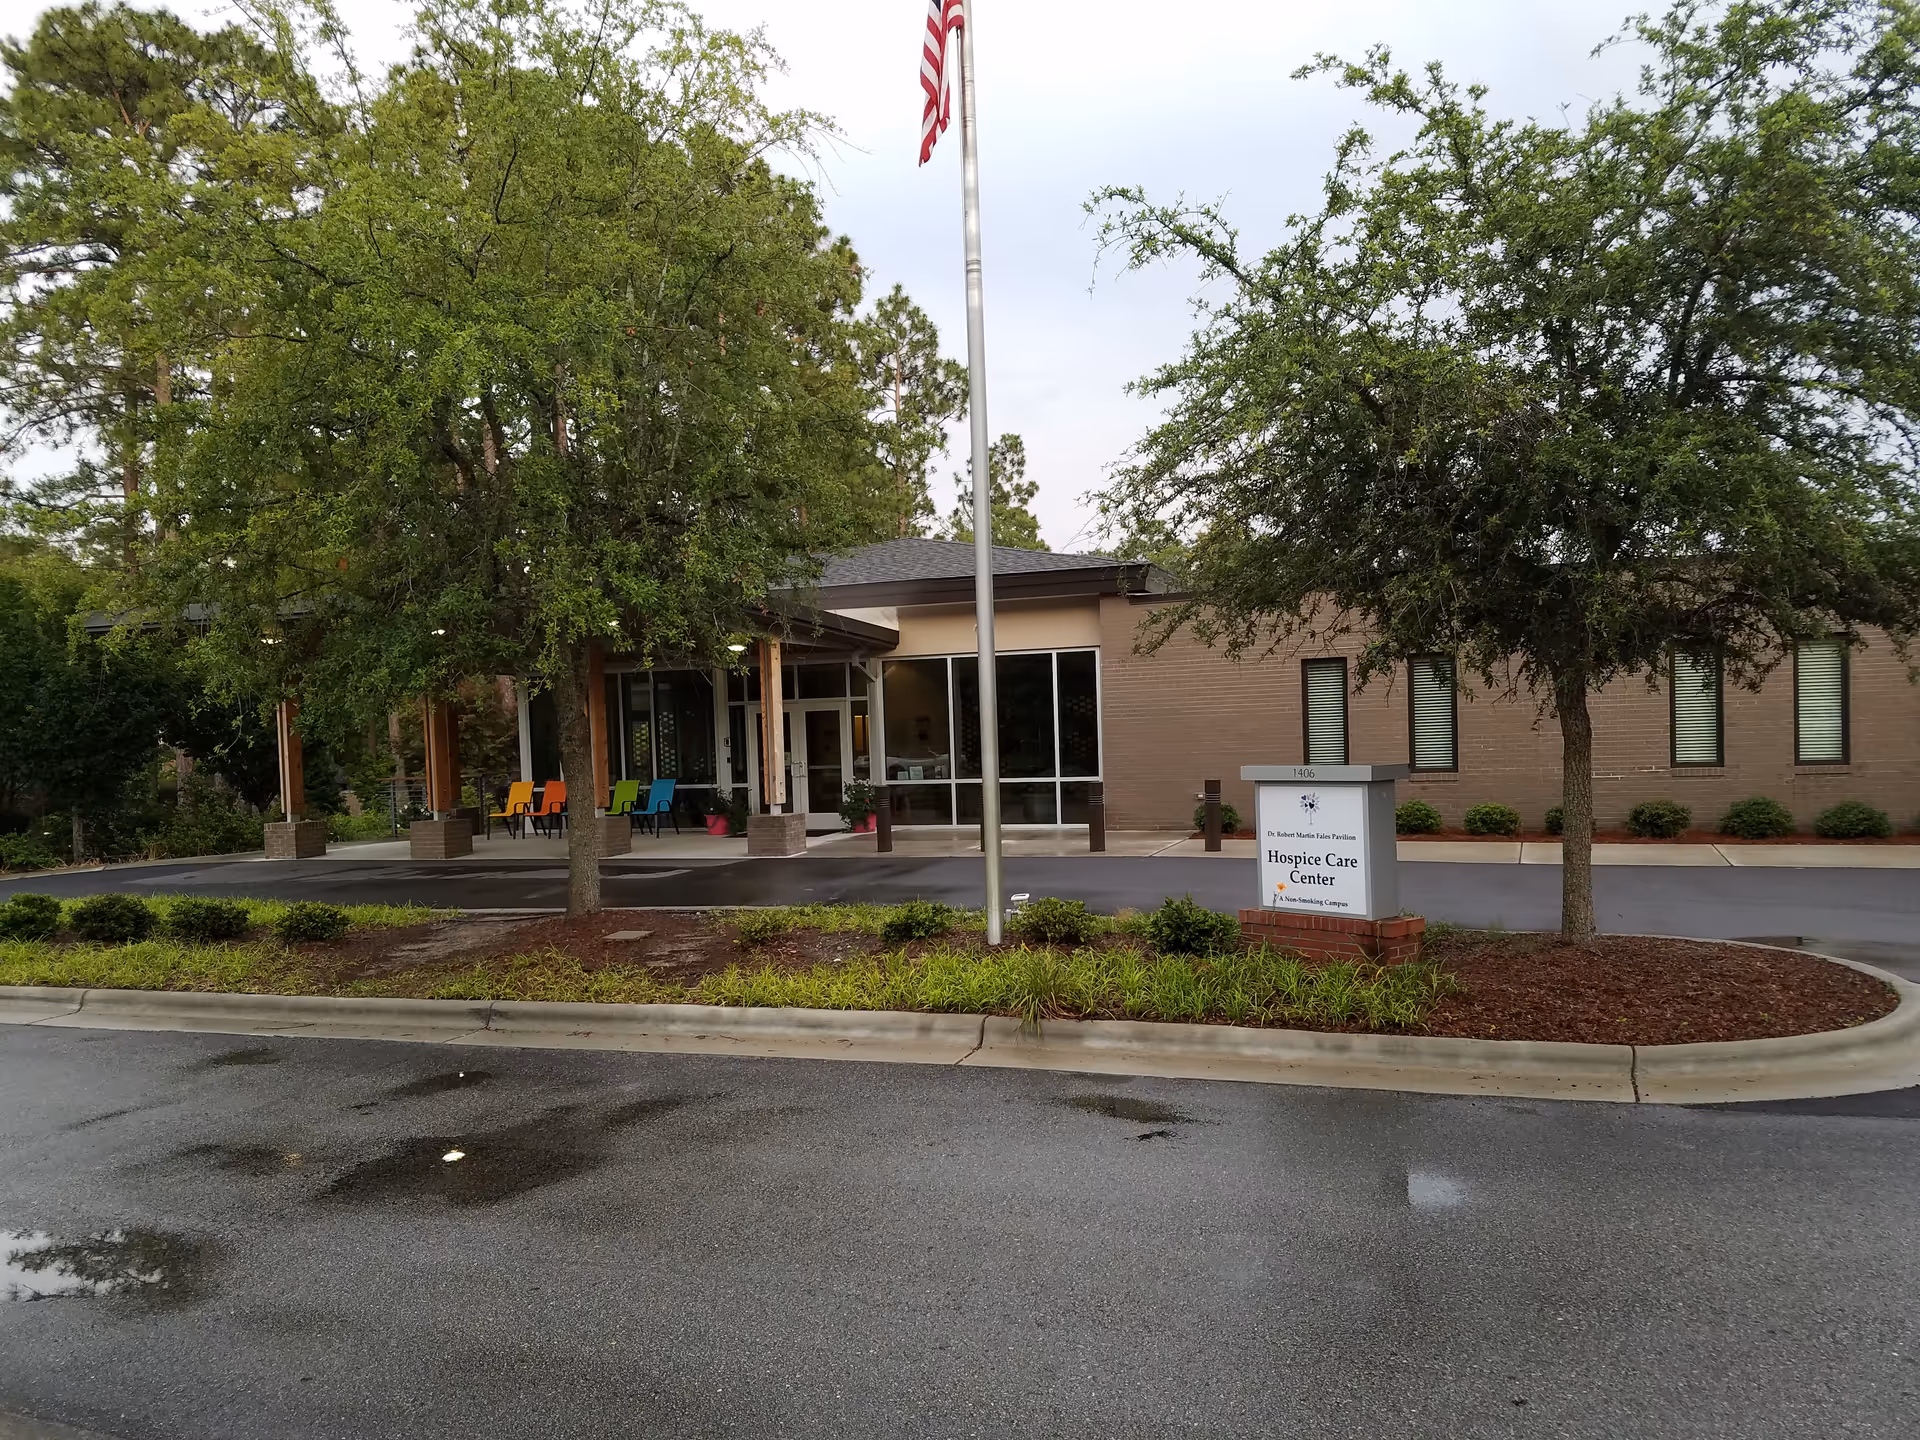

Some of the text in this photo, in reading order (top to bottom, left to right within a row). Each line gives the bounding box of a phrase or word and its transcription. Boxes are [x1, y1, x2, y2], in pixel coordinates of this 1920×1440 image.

[1293, 768, 1315, 778] 1406
[1268, 850, 1358, 868] Hospice Care
[1290, 870, 1335, 886] Center
[1285, 896, 1324, 906] Non-Smoking
[1324, 899, 1348, 908] Campus
